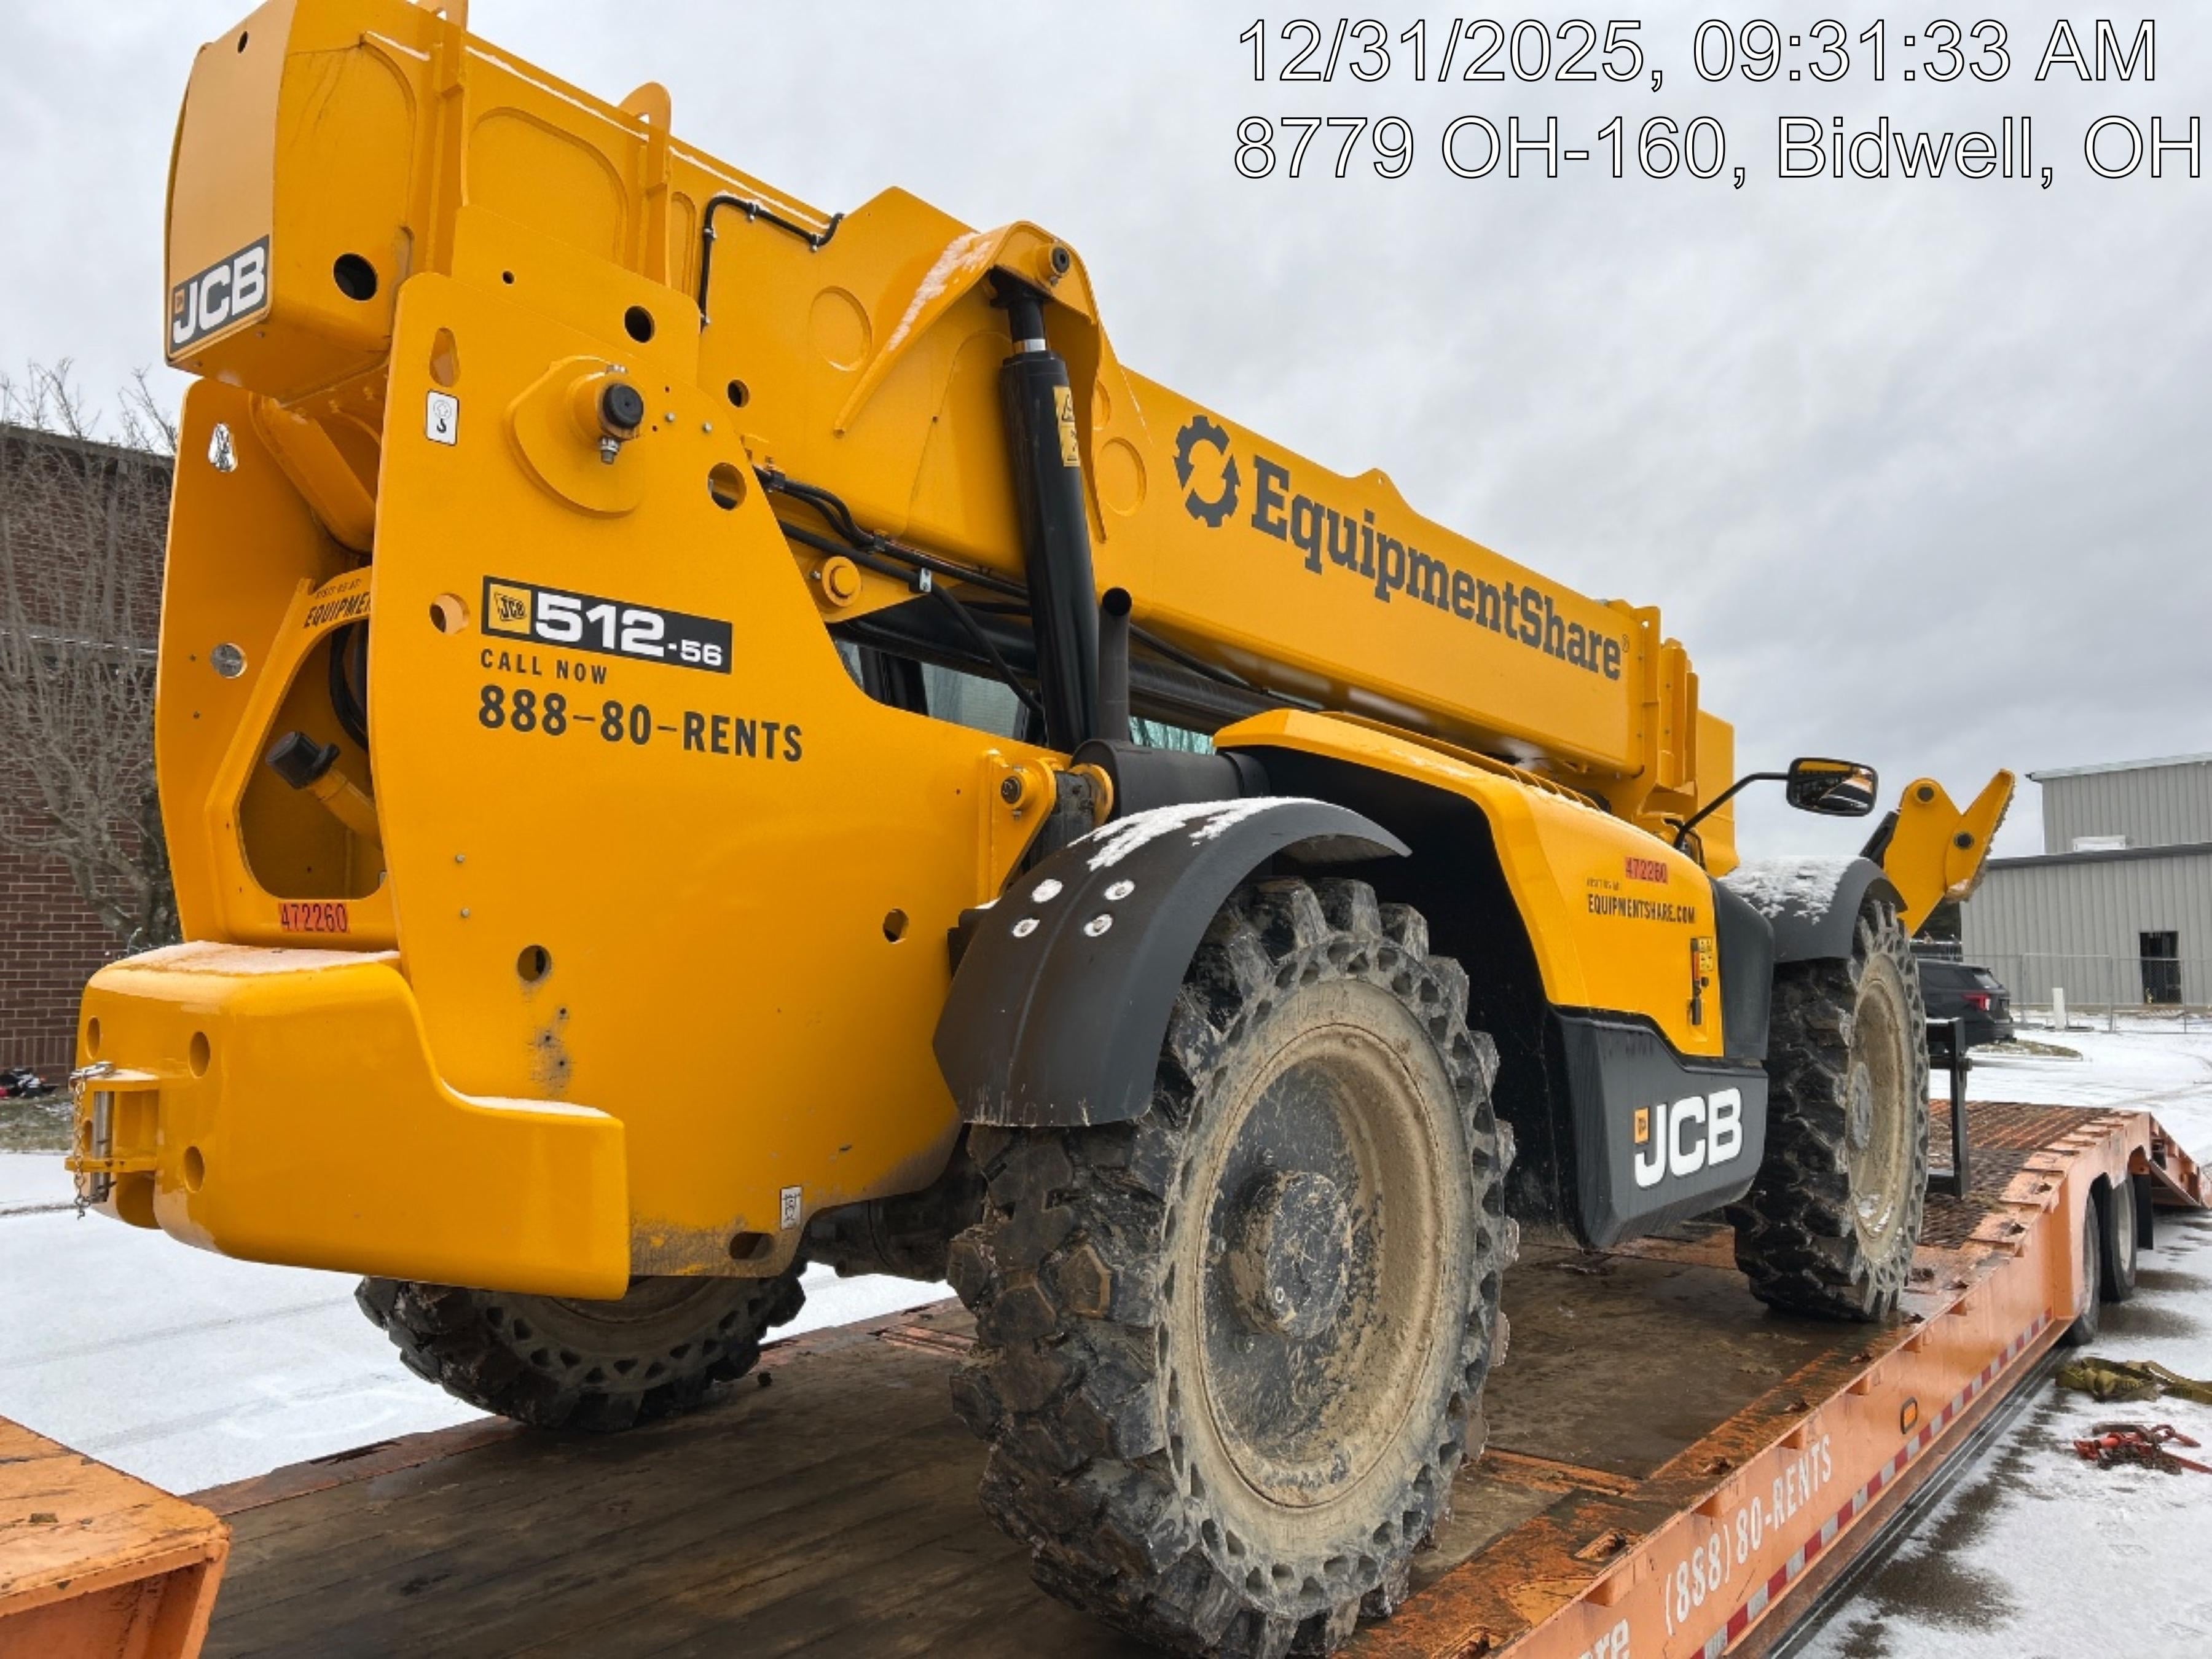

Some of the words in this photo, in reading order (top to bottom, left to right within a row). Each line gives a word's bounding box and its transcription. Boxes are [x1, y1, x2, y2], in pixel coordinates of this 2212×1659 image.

[172, 246, 265, 344] JCB
[480, 648, 543, 676] CALL
[555, 659, 608, 685] NOW
[535, 591, 723, 667] 512-56
[478, 683, 804, 763] 888-80-RENTS
[281, 902, 348, 933] 472260
[1587, 893, 1695, 924] EQUIPMENTSHARE.COM
[1634, 1086, 1743, 1188] JCB
